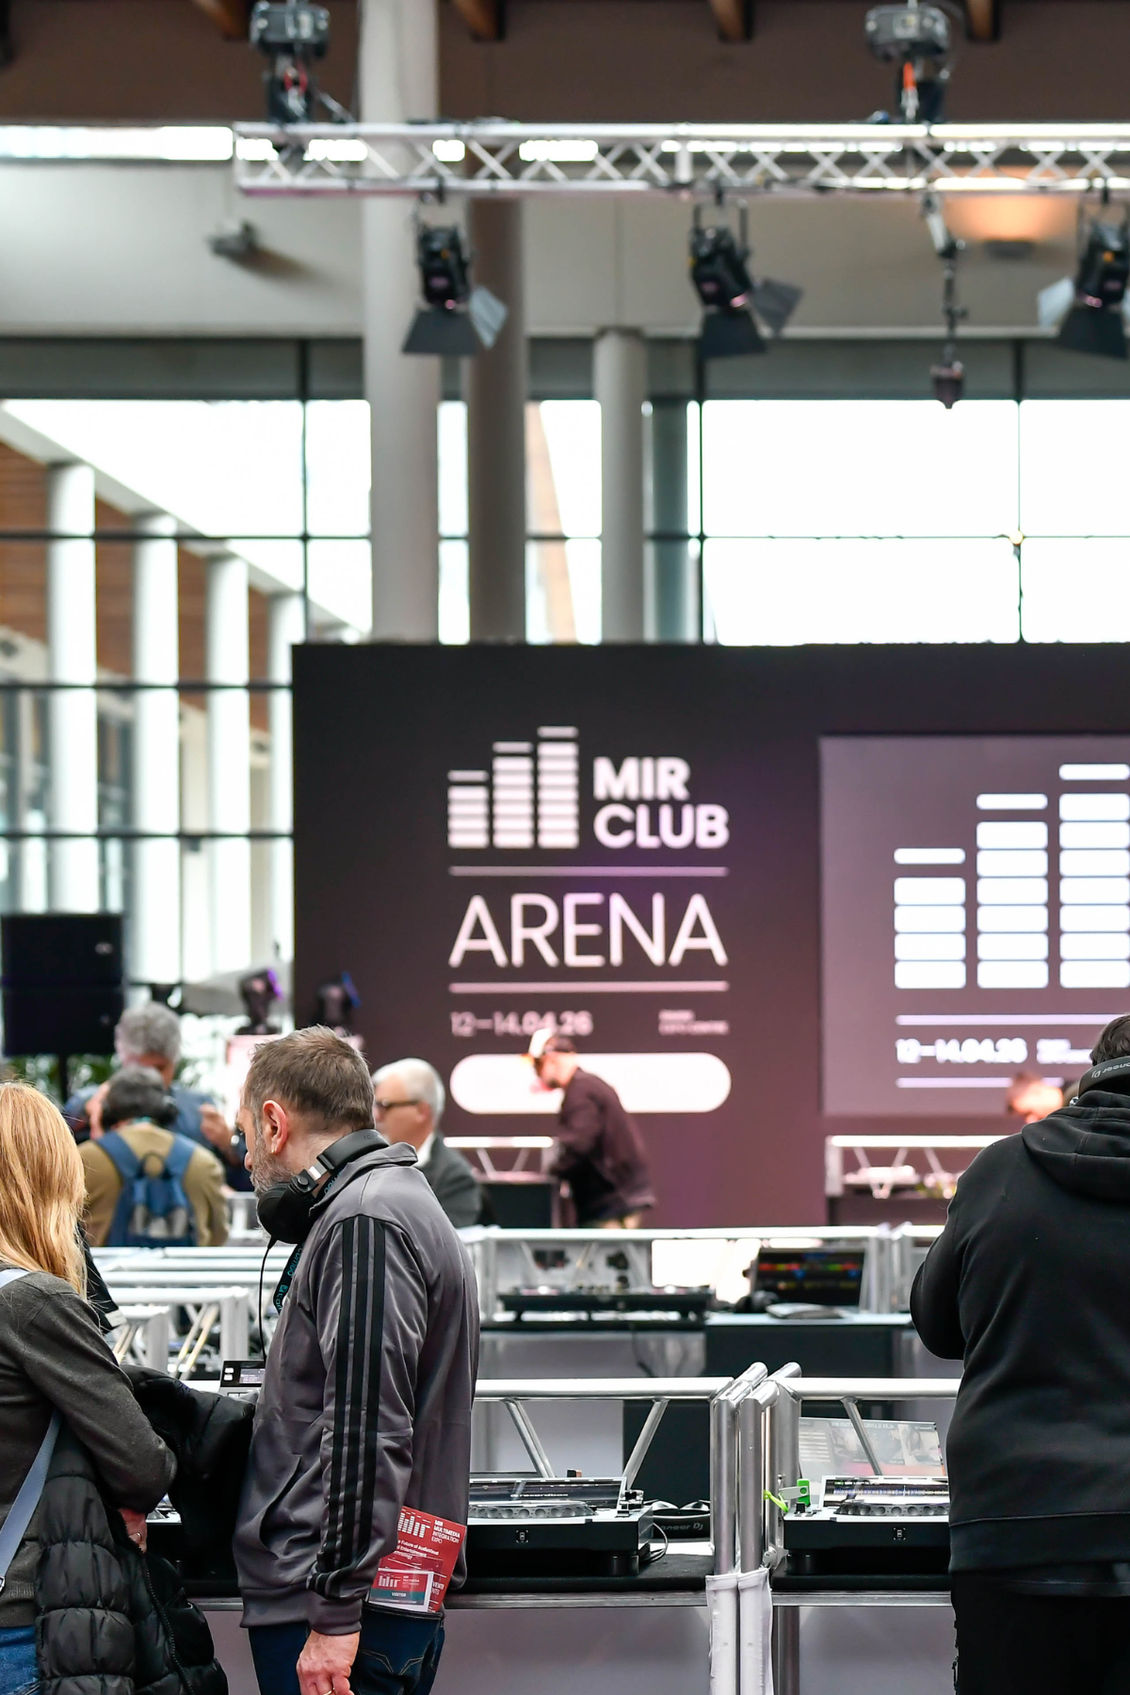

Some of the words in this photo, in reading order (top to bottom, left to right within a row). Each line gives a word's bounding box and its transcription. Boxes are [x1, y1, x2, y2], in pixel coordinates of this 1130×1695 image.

[593, 757, 690, 801] MIR
[593, 803, 730, 849] CLUB
[449, 892, 729, 968] ARENA
